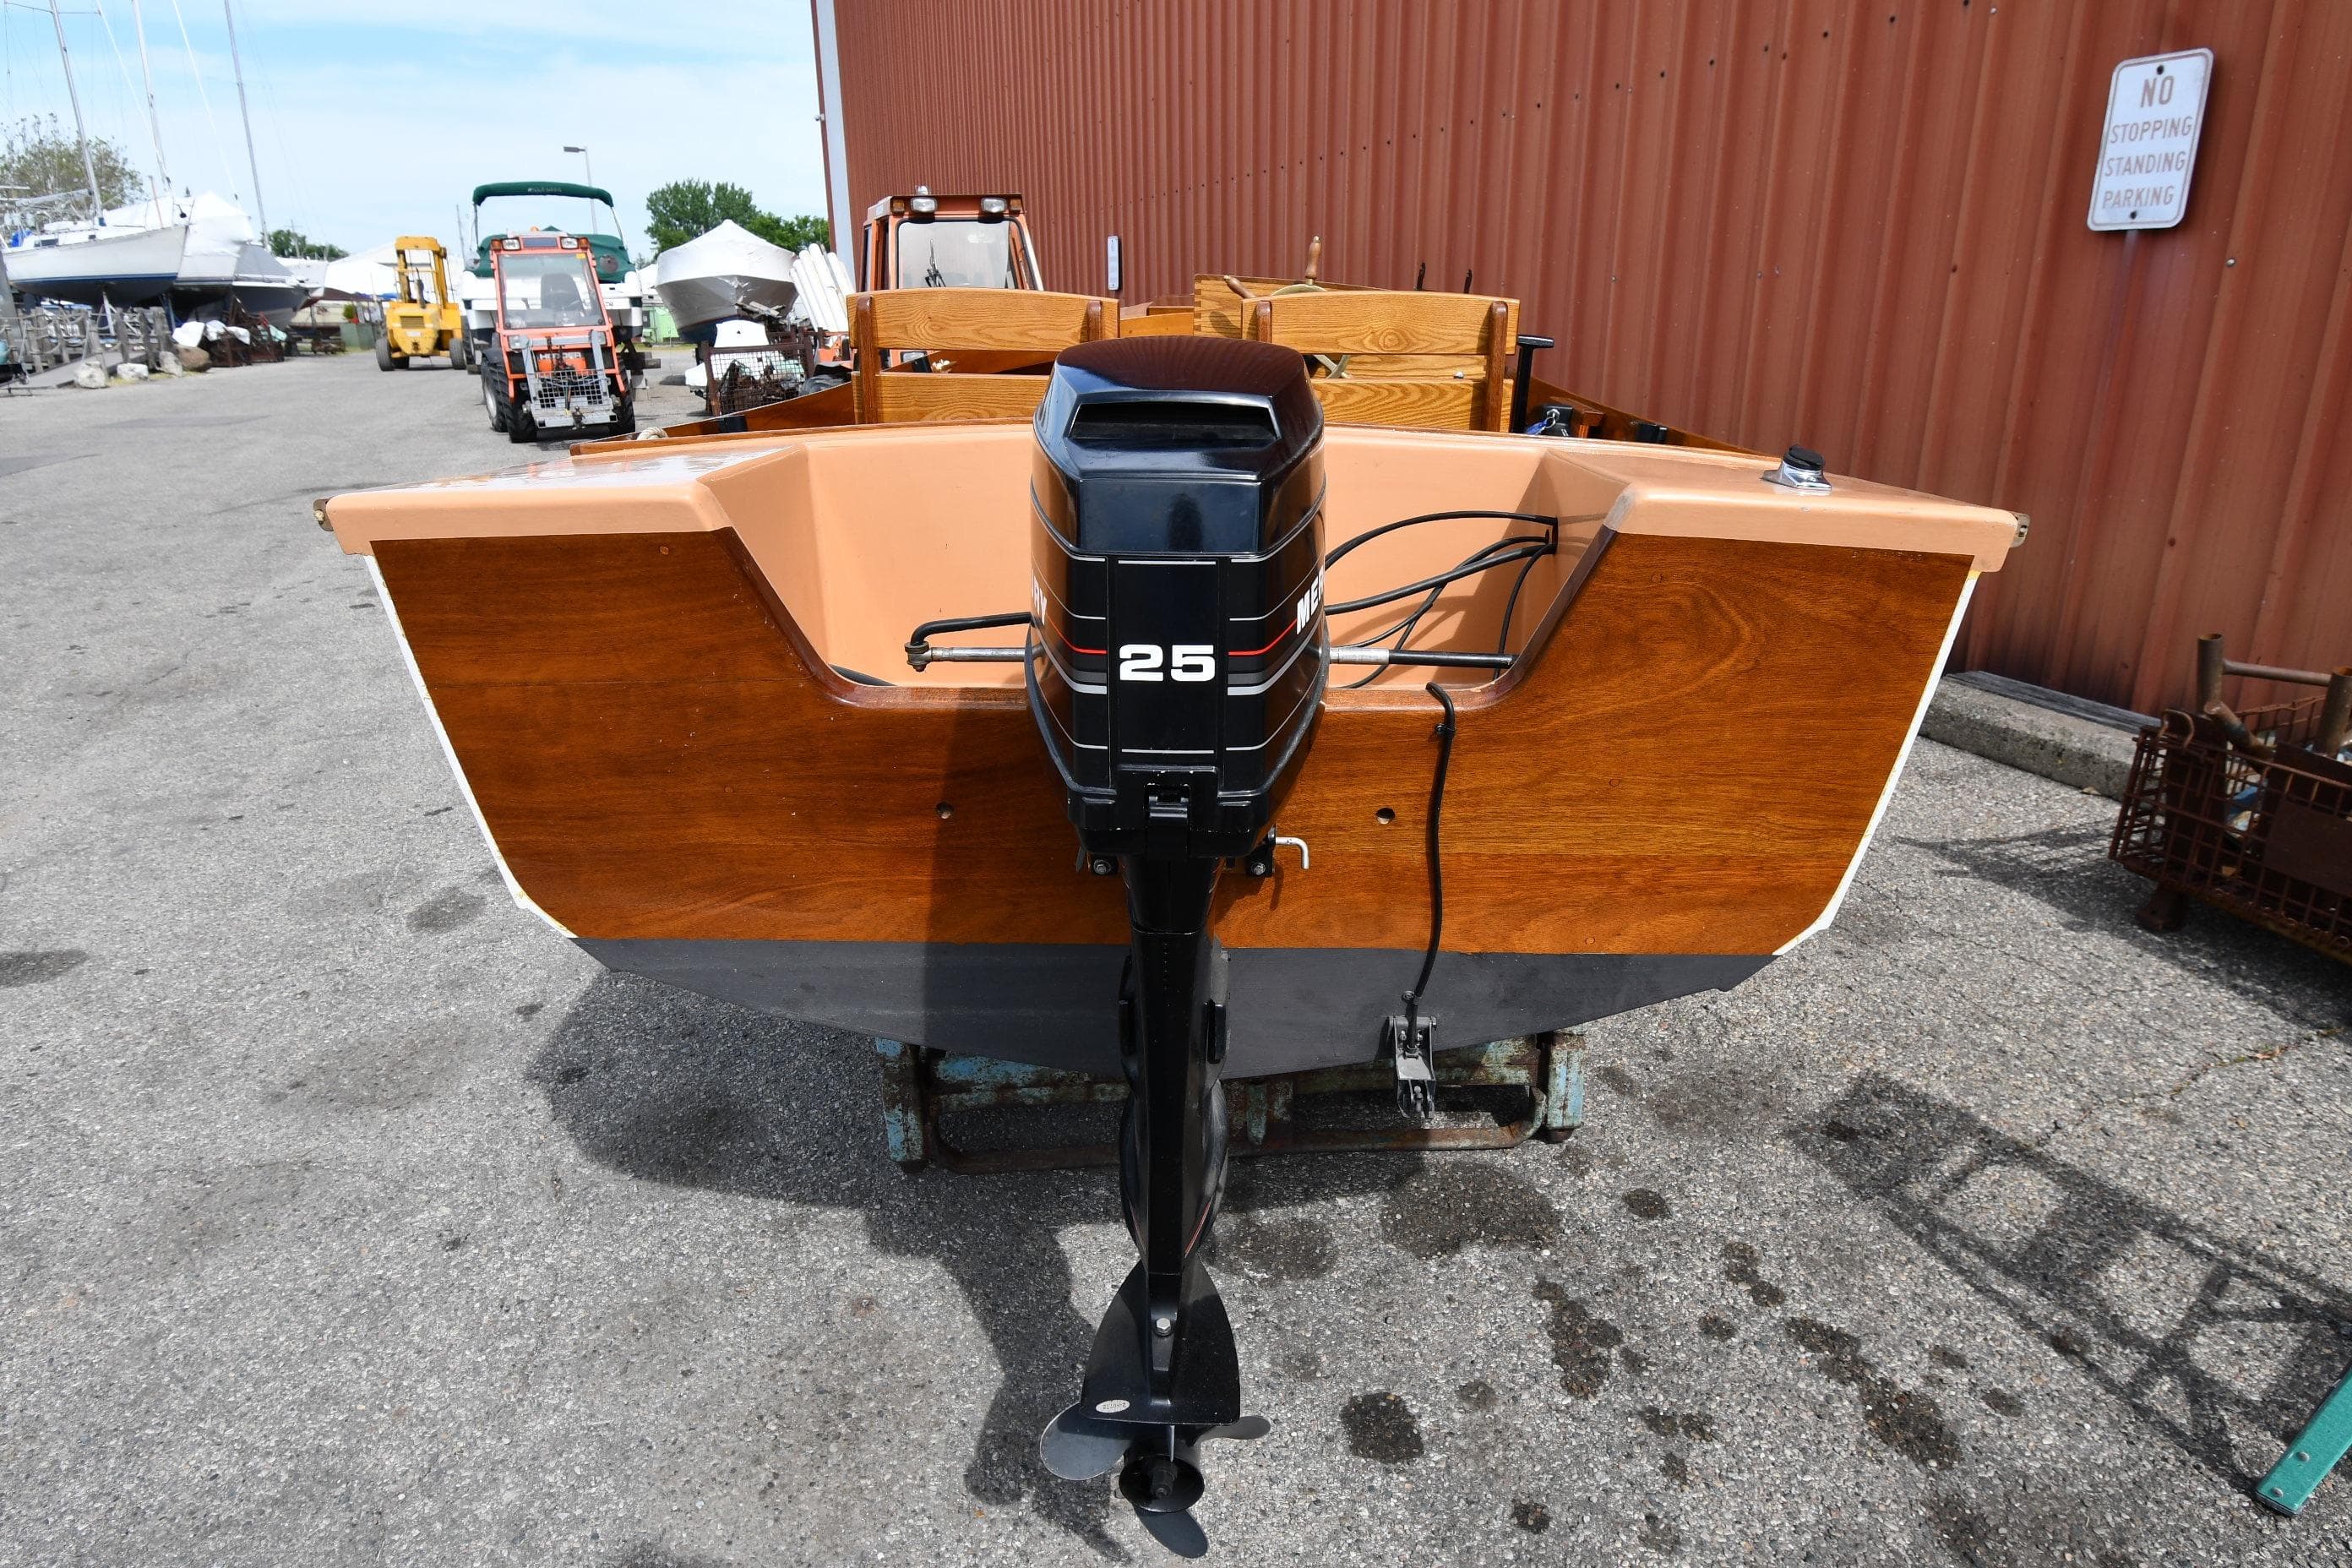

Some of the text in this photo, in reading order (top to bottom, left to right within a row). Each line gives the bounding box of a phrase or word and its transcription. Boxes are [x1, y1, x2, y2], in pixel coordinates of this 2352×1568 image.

[2140, 75, 2175, 108] NO
[2110, 116, 2194, 144] STOPPING
[2104, 151, 2186, 177] STANDING
[2102, 185, 2175, 210] PARKING
[1119, 644, 1217, 683] 25
